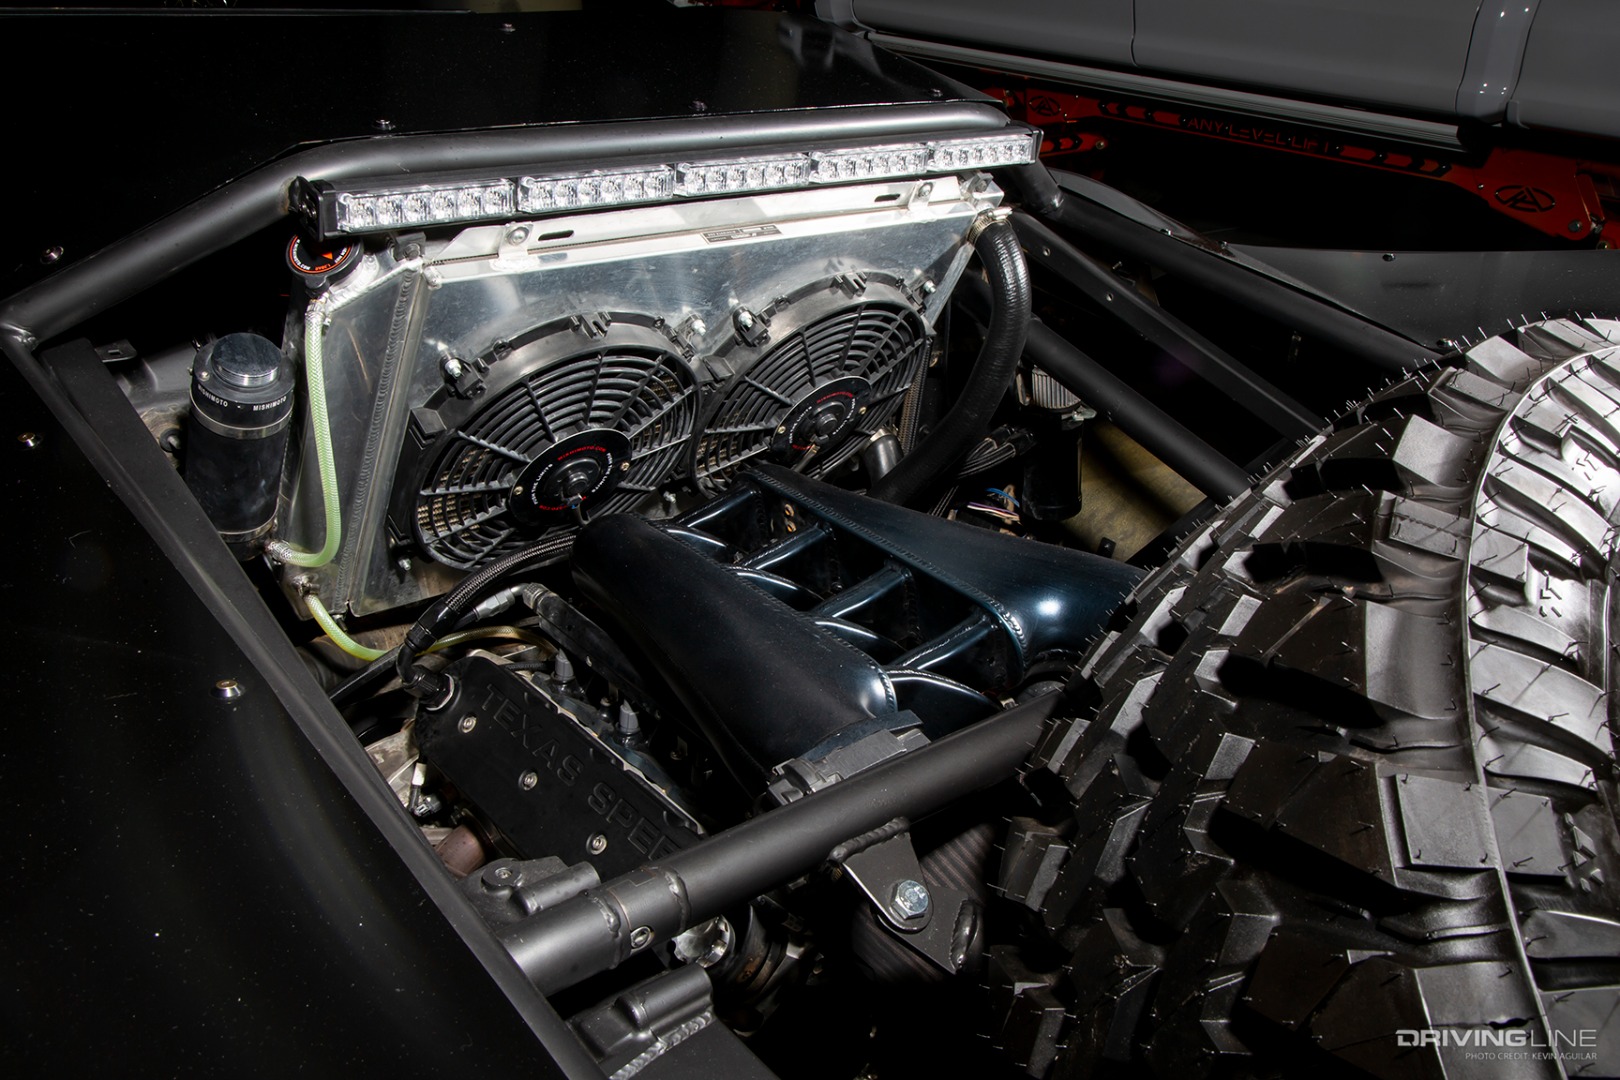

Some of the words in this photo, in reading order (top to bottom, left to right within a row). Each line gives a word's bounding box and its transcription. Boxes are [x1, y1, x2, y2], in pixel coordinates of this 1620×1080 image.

[1187, 117, 1224, 134] ANY
[1228, 123, 1287, 146] LEVEL
[252, 395, 287, 412] MISHIMOTO
[481, 683, 585, 787] TEXAS
